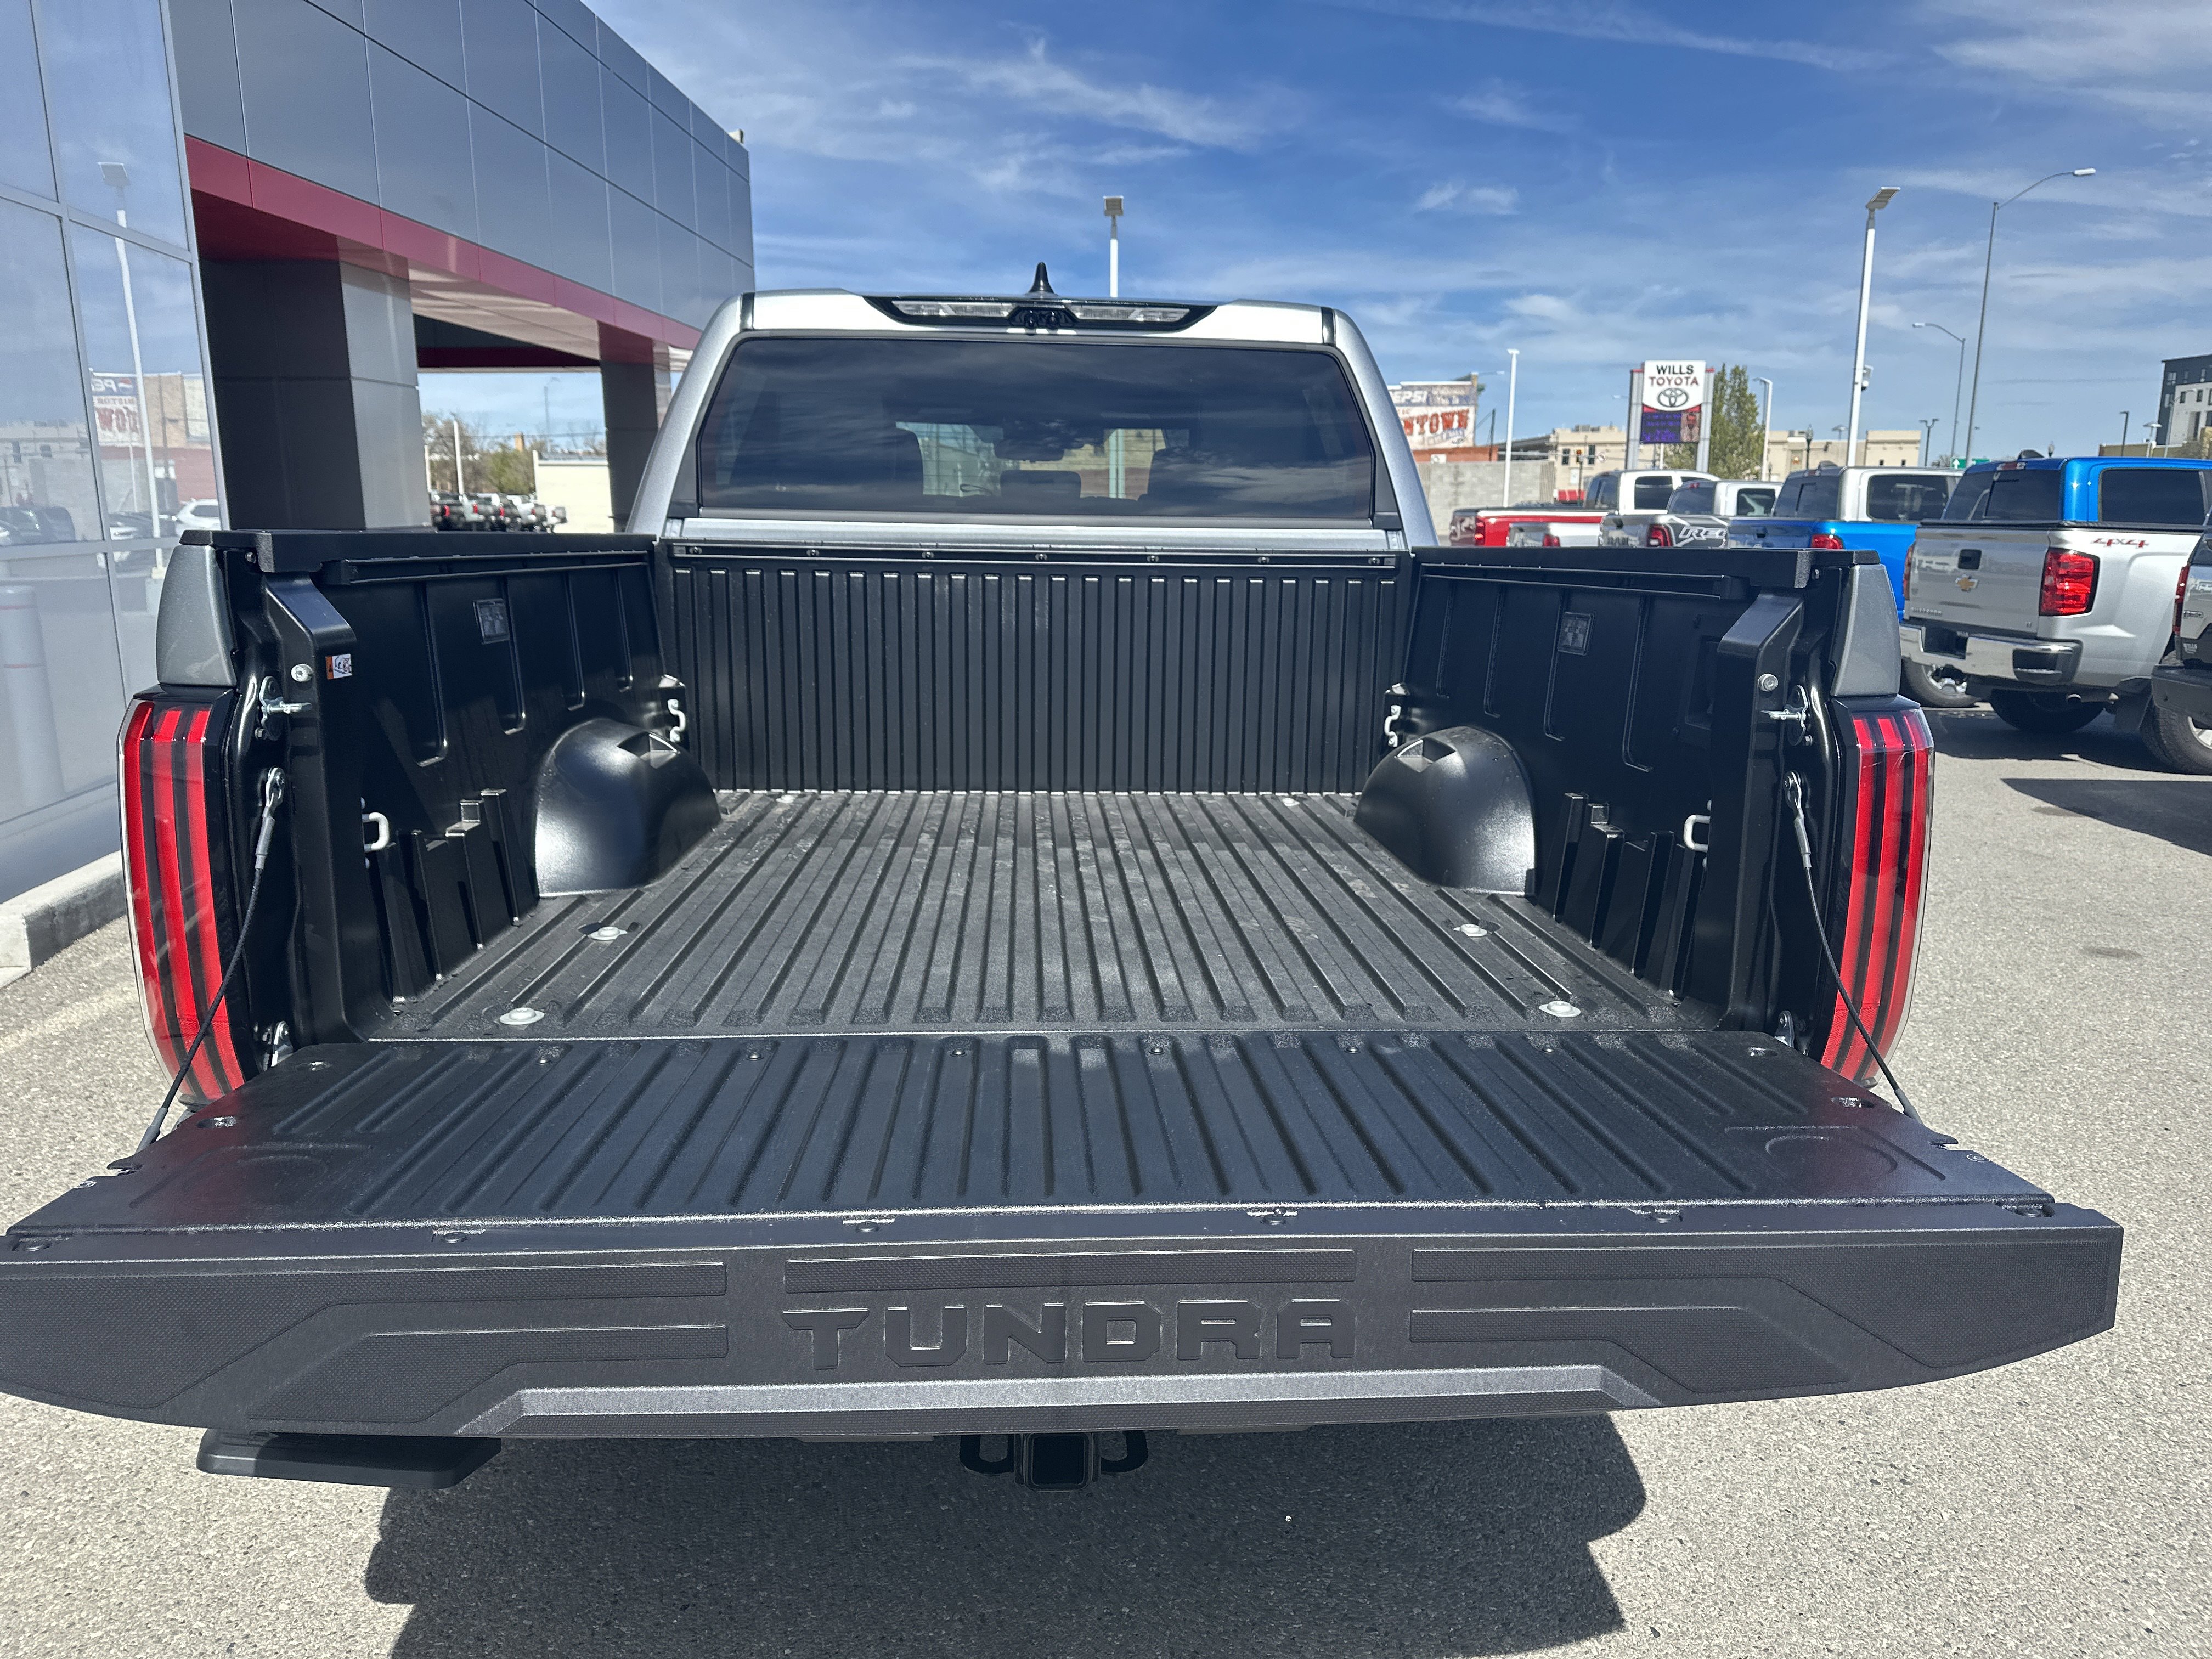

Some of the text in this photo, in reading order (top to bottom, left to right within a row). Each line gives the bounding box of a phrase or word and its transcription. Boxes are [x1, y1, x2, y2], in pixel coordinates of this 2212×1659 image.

[1656, 364, 1694, 375] WILLS
[1649, 376, 1699, 386] TOYOTA
[1391, 390, 1428, 405] EPSI
[1402, 409, 1469, 437] NTOWN
[782, 1298, 1356, 1370] TUNDRA
